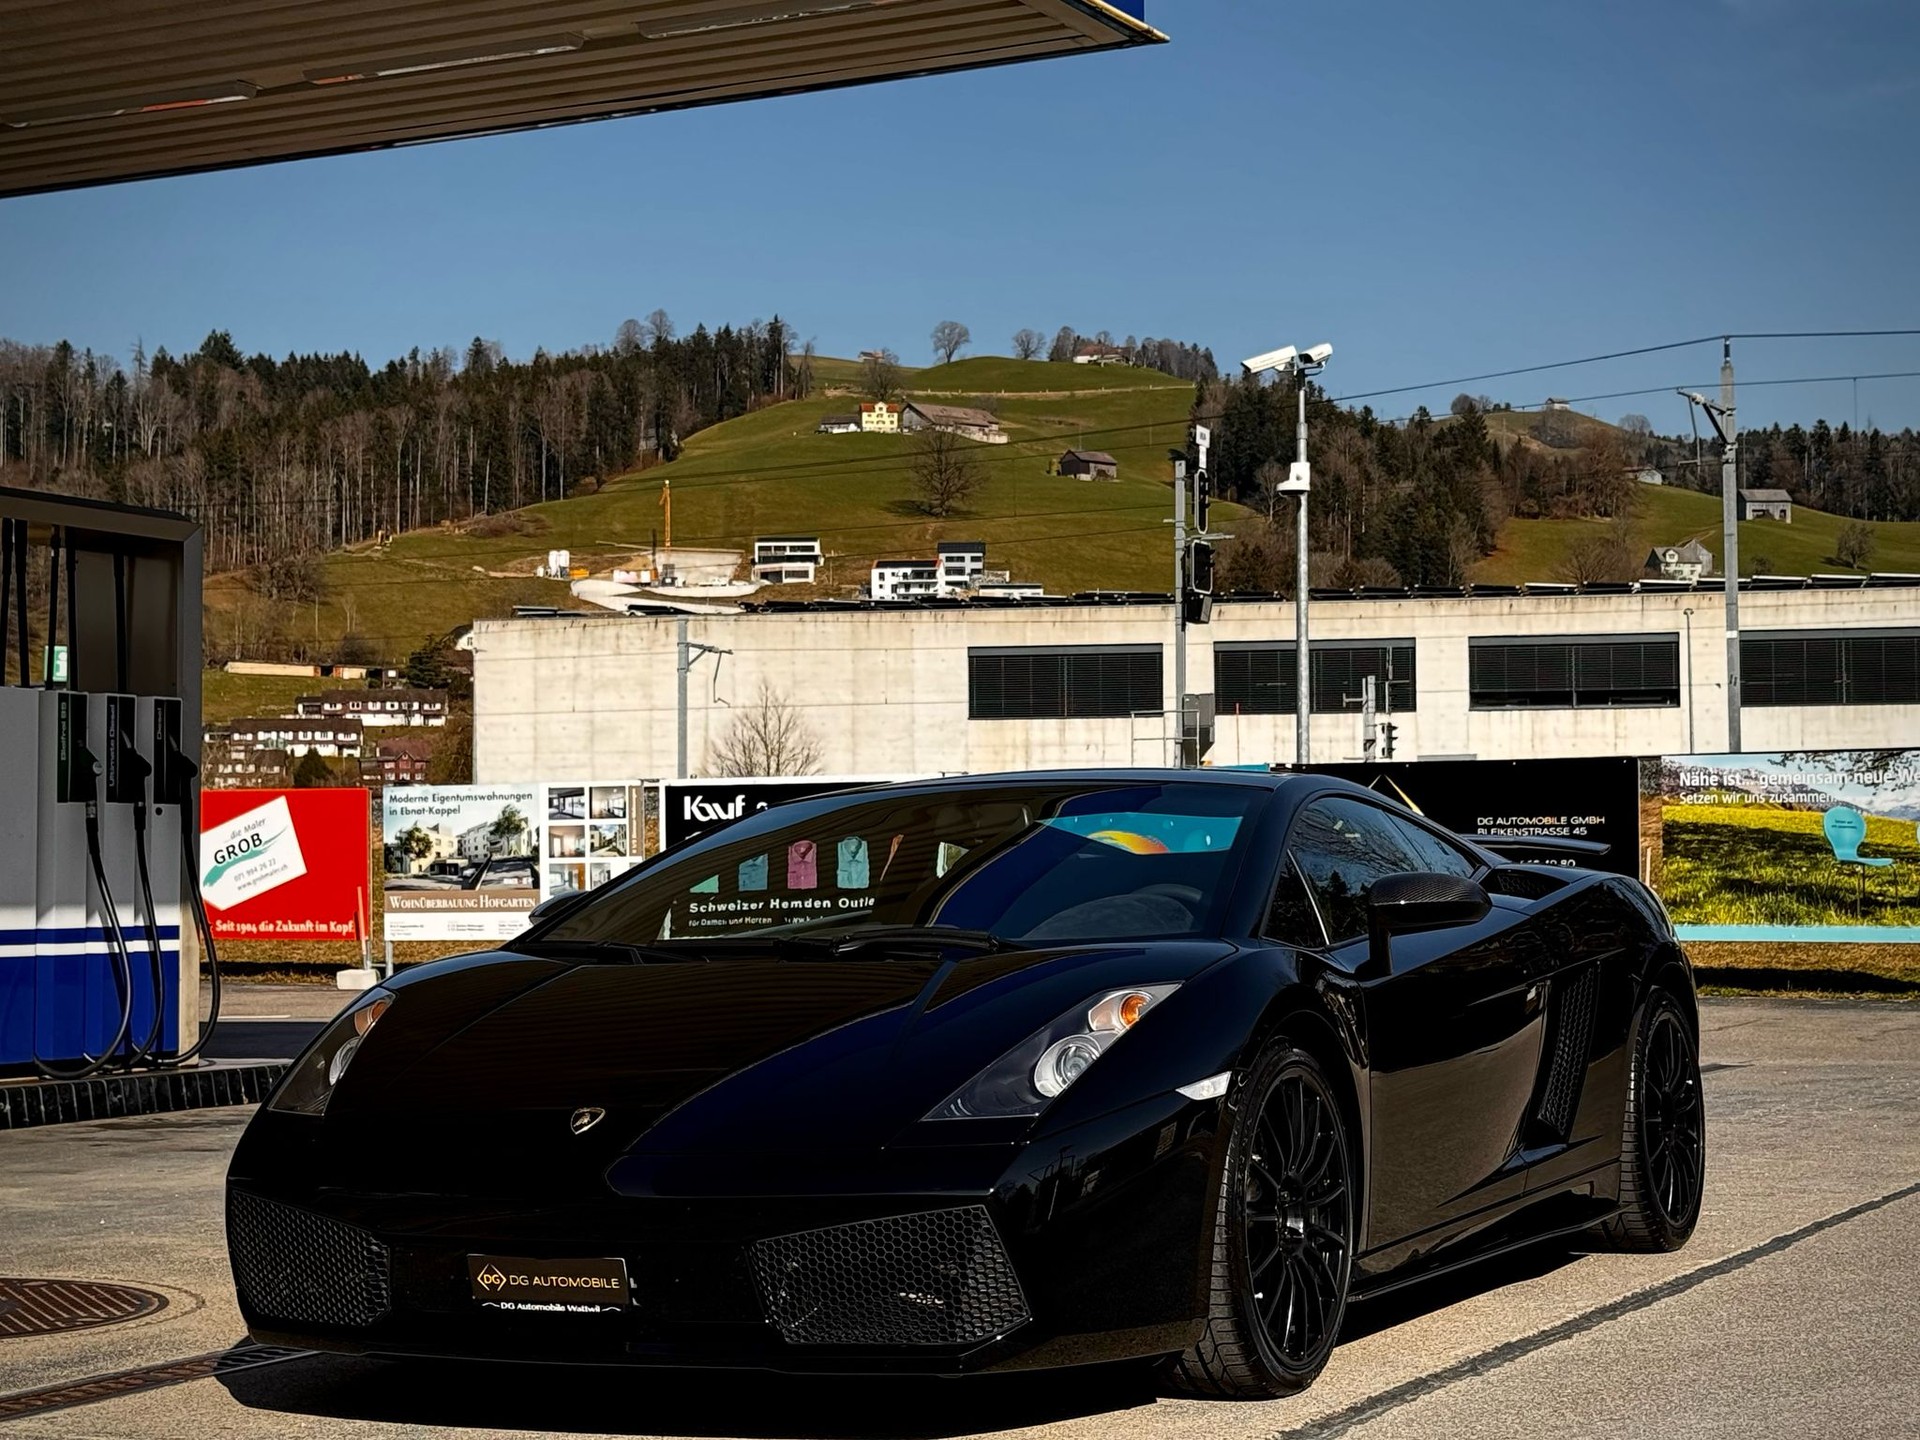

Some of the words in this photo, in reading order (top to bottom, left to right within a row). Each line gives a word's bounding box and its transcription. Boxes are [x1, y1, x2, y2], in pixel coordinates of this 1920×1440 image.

[1679, 770, 1718, 787] Nähe
[1759, 769, 1848, 788] gemeinsam
[1854, 770, 1891, 784] neue
[389, 794, 429, 804] Moderne
[432, 791, 533, 804] Eigentumswohnungen
[1679, 792, 1718, 804] Setzen
[1721, 792, 1740, 804] wir
[1744, 793, 1765, 804] uns
[400, 805, 460, 817] Ebnat-Kappel
[684, 794, 746, 822] Kauf
[244, 818, 267, 833] Maler
[1477, 816, 1494, 826] DG
[1496, 816, 1568, 825] AUTOMOBILE
[1570, 816, 1606, 825] GMBH
[1572, 826, 1588, 836] 45
[214, 832, 262, 865] GROB
[689, 900, 764, 914] Schweizer
[769, 898, 832, 910] Hemden
[216, 919, 235, 932] Seit
[236, 922, 258, 935] 1904
[258, 920, 274, 932] die
[276, 920, 314, 932] Zukunft
[316, 920, 328, 932] im
[483, 1274, 500, 1285] DG
[509, 1275, 530, 1286] DG
[532, 1276, 620, 1289] AUTOMOBILE
[500, 1302, 515, 1310] DG
[516, 1303, 566, 1312] Automobile
[567, 1304, 600, 1313] Wattwil
